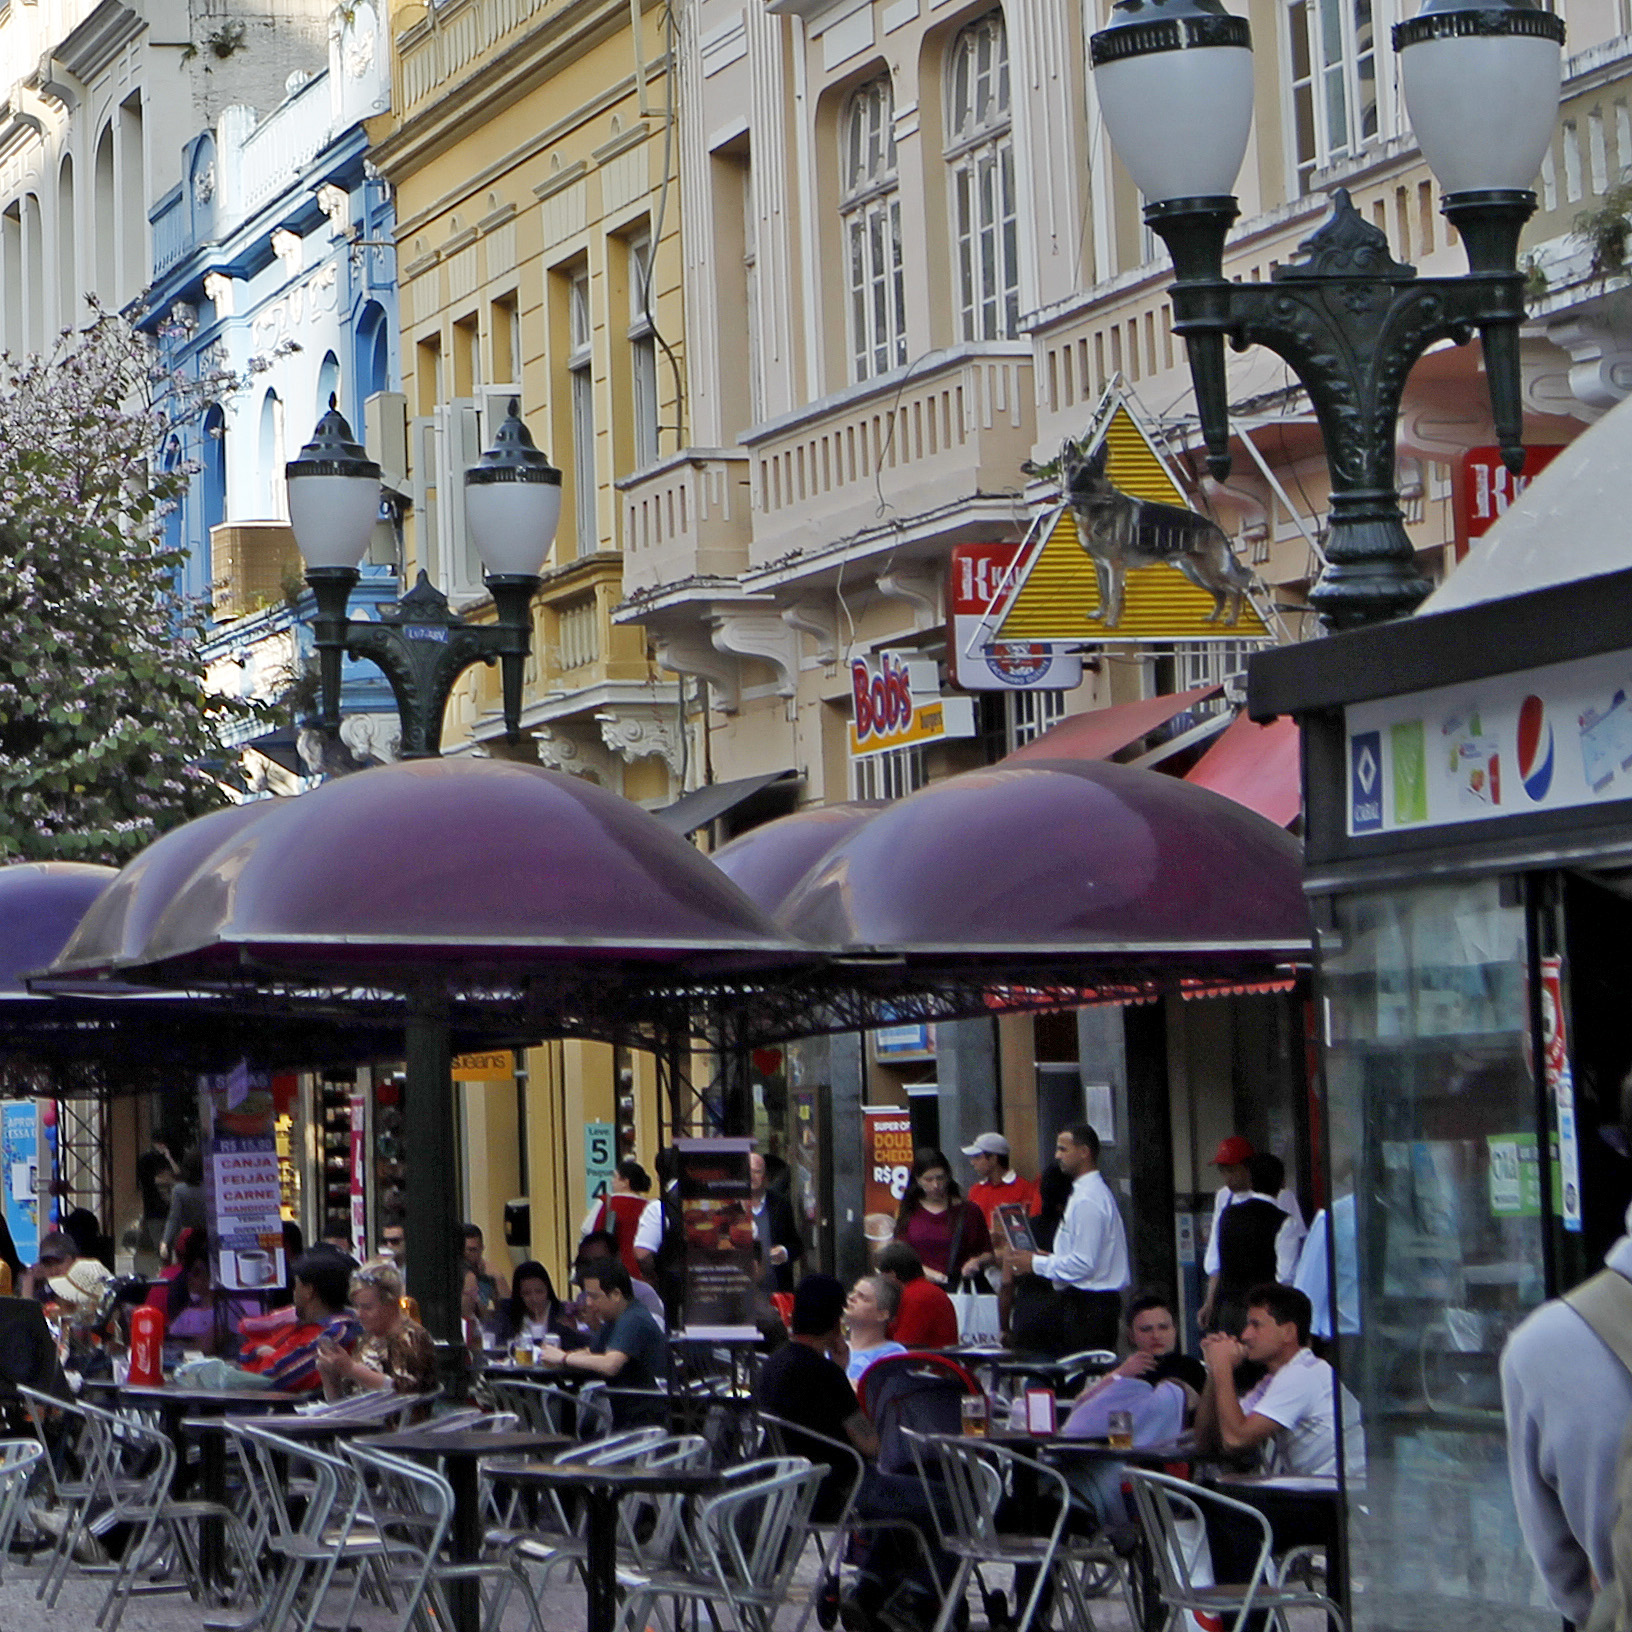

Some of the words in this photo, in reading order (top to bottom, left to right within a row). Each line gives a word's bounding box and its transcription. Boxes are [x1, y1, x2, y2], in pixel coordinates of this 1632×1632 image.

[851, 652, 914, 744] Bob's
[591, 1139, 608, 1164] 5
[221, 1157, 273, 1167] CANJA
[221, 1172, 278, 1185] FEIJÃO
[223, 1190, 275, 1201] CARNE
